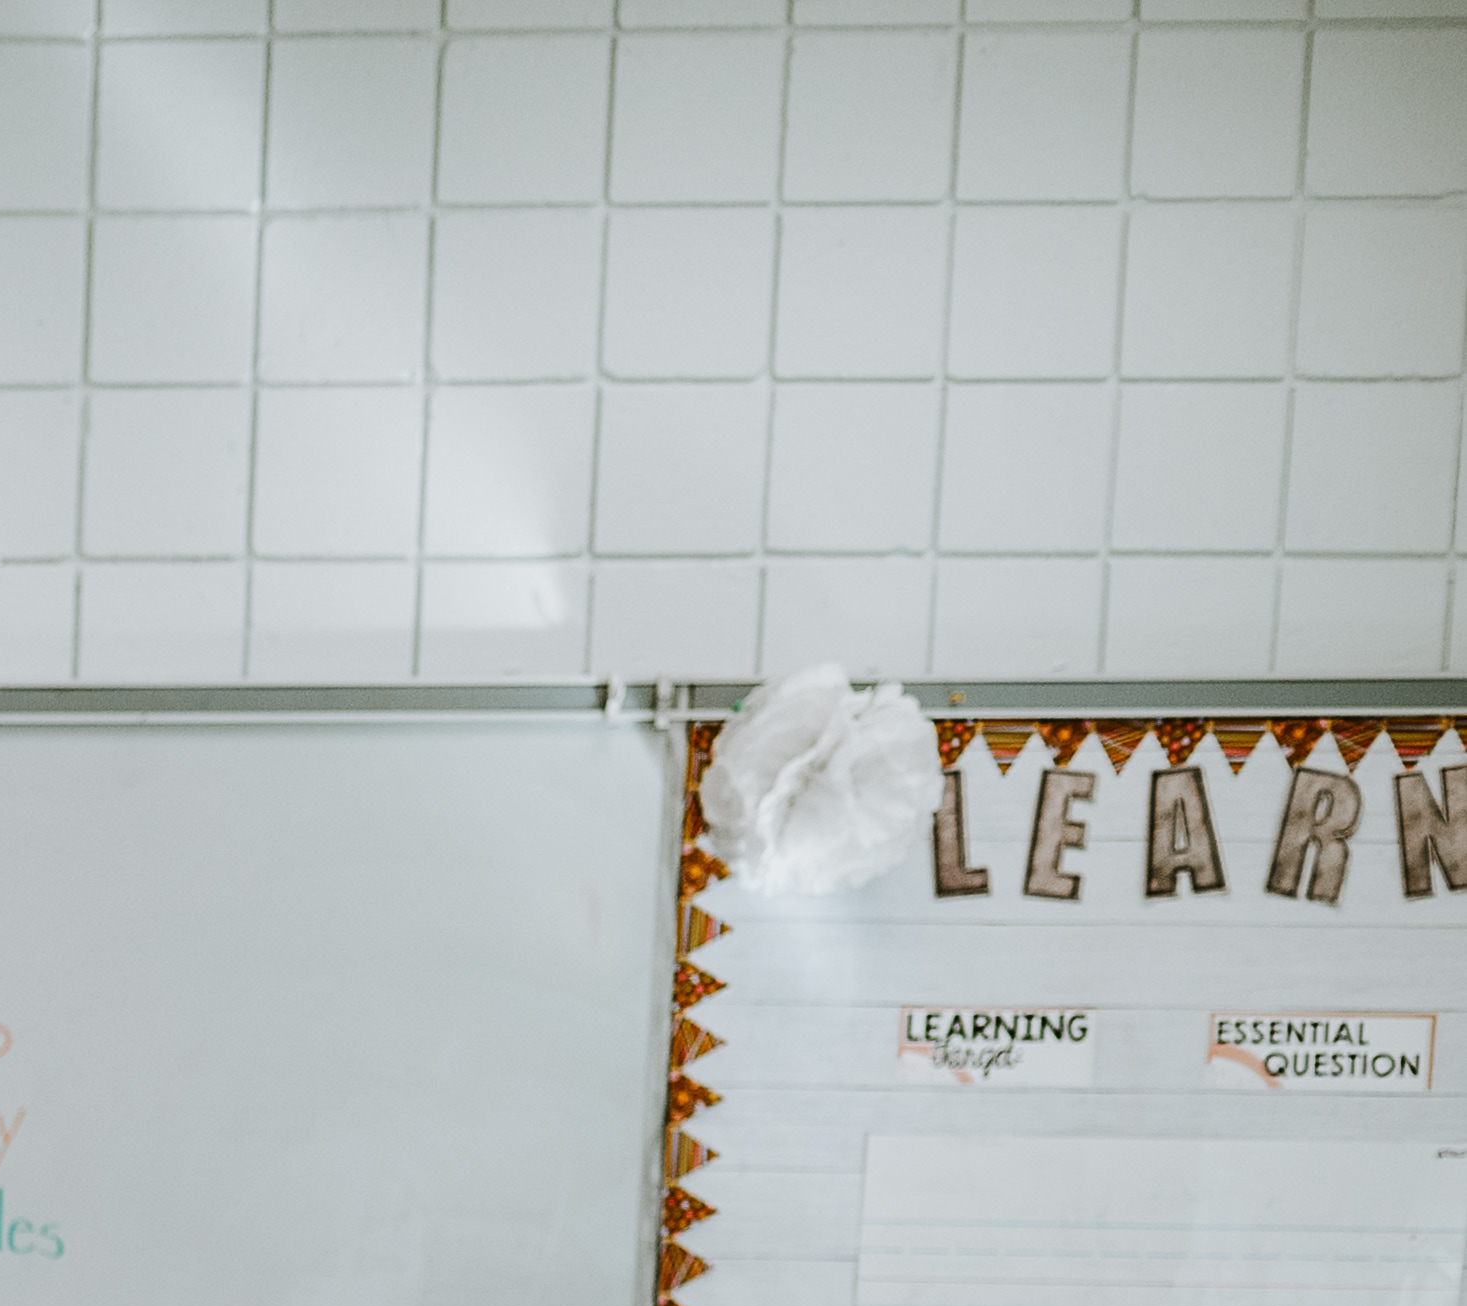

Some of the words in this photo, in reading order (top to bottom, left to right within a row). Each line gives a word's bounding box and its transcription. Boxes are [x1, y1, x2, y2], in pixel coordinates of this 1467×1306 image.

[906, 1013, 1088, 1042] LEARNING
[1217, 1020, 1369, 1045] ESSENTIAL
[1264, 1052, 1420, 1077] QUESTION
